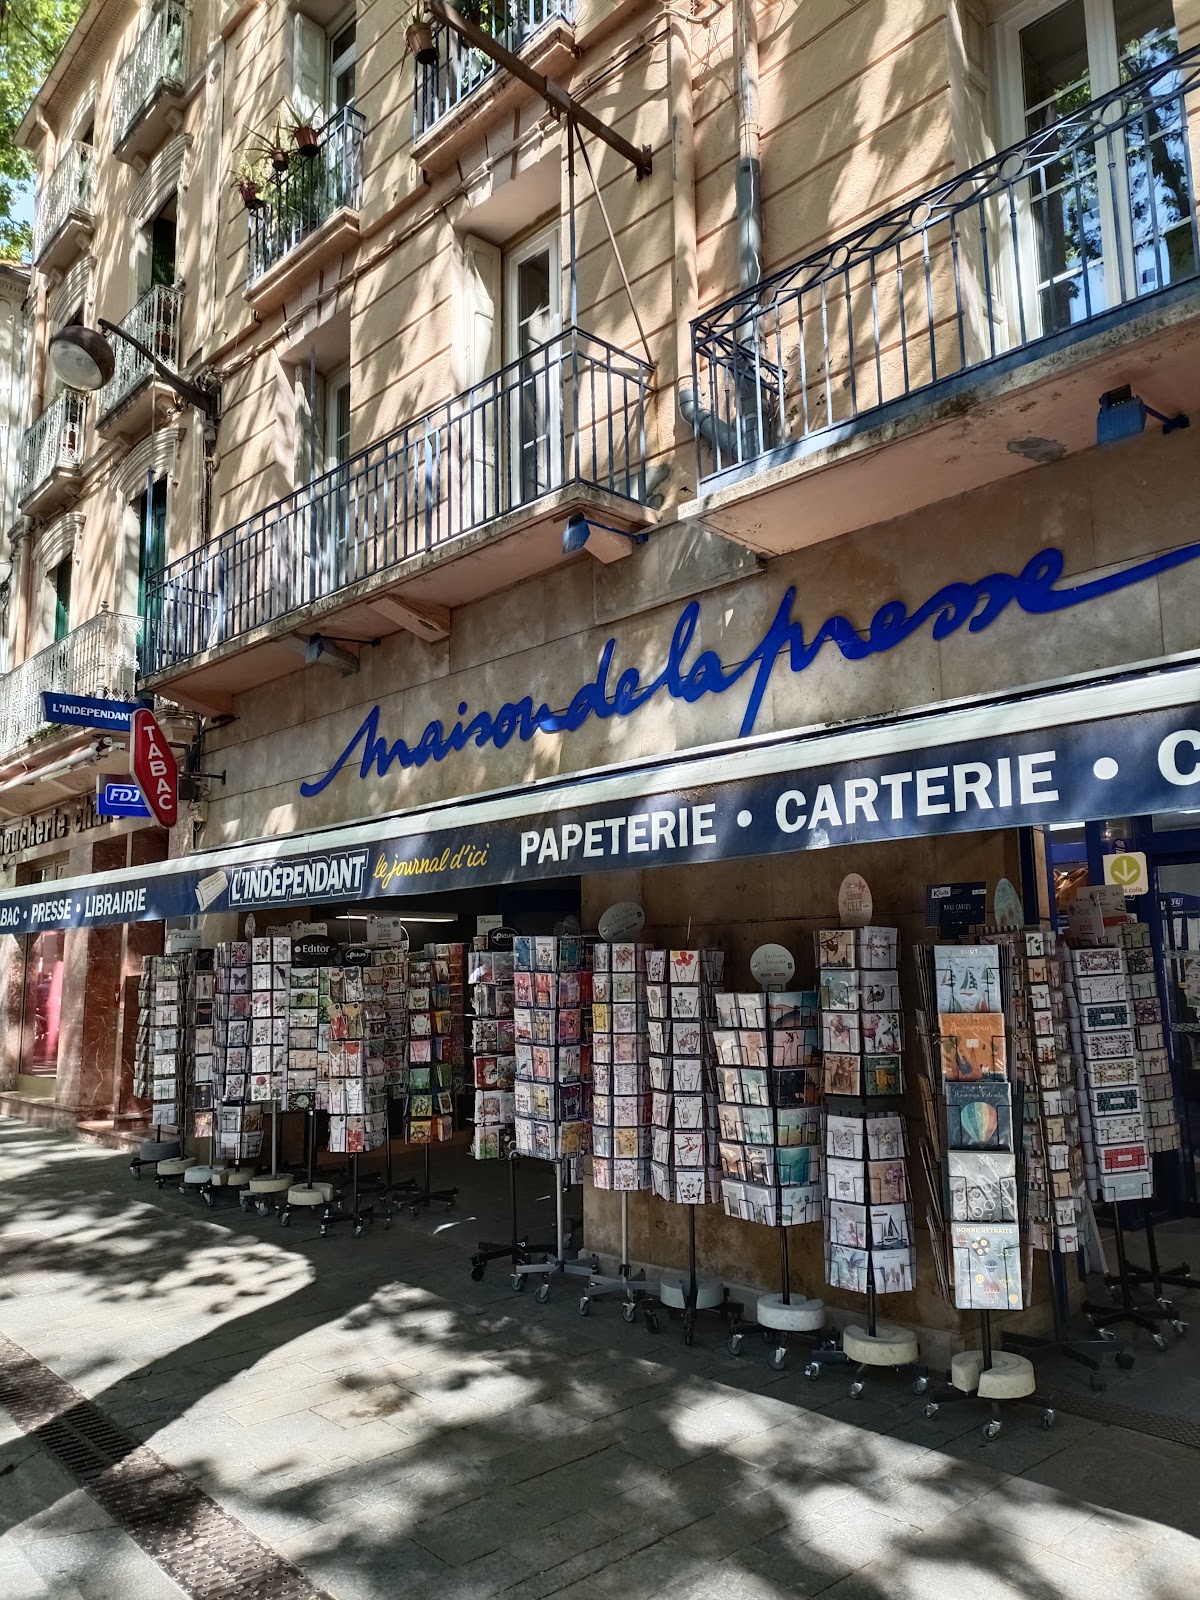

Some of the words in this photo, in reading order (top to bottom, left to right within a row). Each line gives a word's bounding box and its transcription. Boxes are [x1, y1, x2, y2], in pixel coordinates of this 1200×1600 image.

[142, 725, 173, 810] TABAC
[109, 788, 141, 803] FDJ
[519, 803, 717, 867] PAPETERIE
[775, 750, 1060, 834] CARTERIE
[373, 852, 389, 879] le
[381, 847, 451, 889] journal
[450, 842, 491, 870] d'ici
[0, 905, 21, 927] BAC
[30, 898, 73, 924] PRESSE
[84, 887, 148, 918] LIBRAIRIE
[302, 944, 331, 953] Editor
